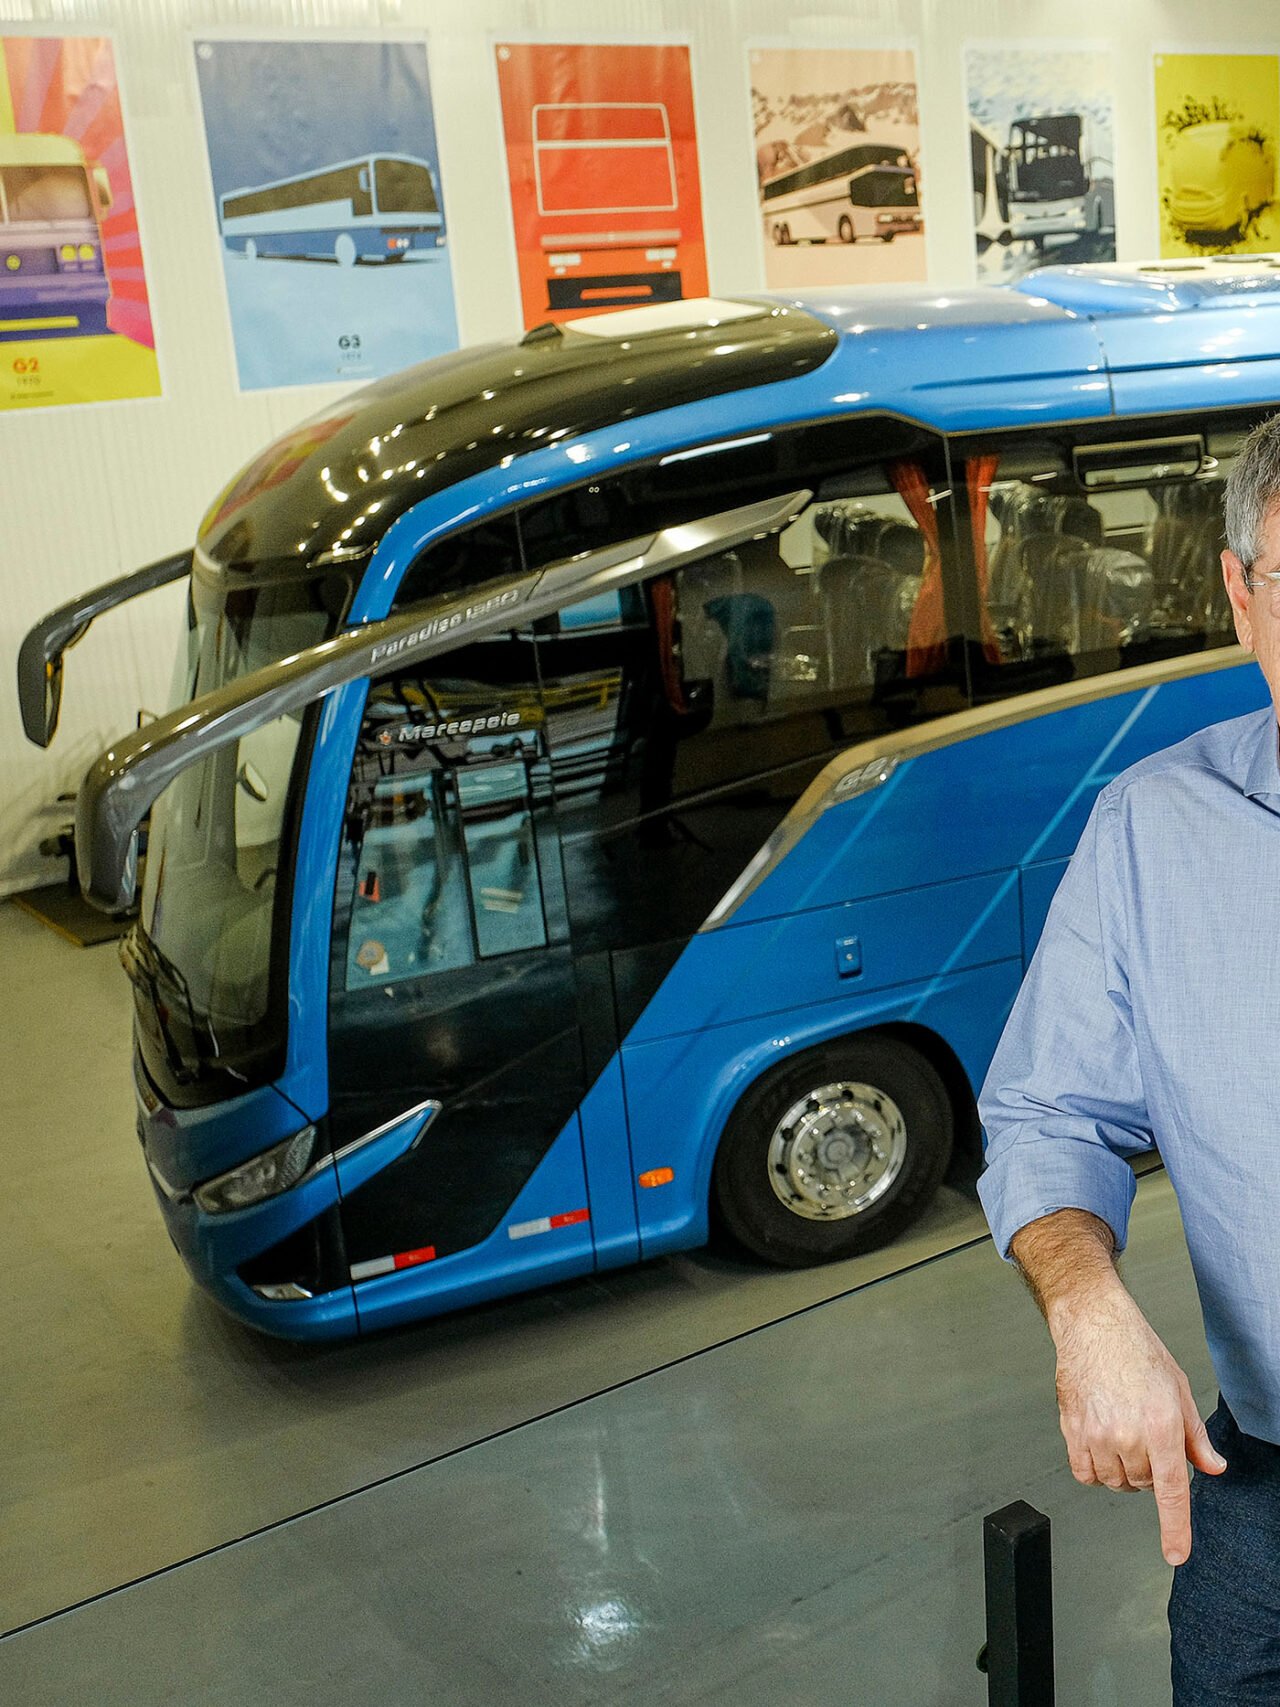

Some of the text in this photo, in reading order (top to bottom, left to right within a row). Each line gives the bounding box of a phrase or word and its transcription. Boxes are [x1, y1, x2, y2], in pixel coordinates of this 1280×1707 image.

[338, 334, 361, 350] G3
[13, 356, 38, 374] G2
[371, 613, 462, 664] Paradiso
[399, 712, 520, 741] Marcopolo
